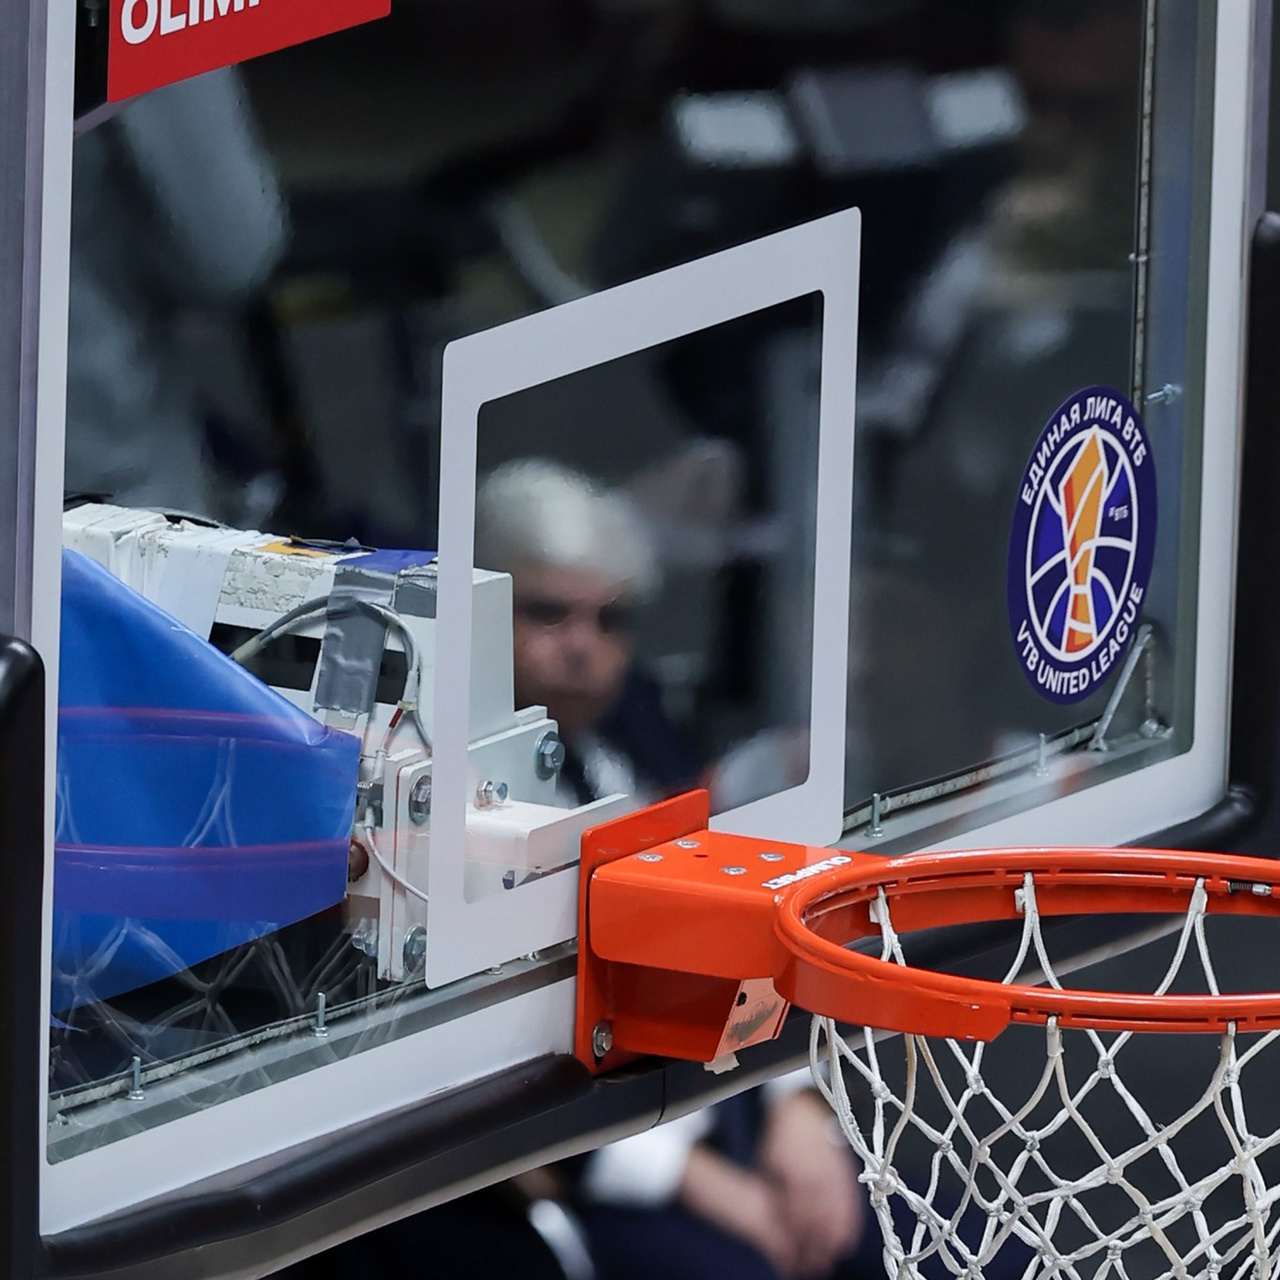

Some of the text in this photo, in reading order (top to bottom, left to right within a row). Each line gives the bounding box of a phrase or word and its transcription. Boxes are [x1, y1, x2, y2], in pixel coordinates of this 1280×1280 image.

[1021, 396, 1147, 506] ЕДИНАЯ ЛИГА ВТБ
[1016, 582, 1144, 695] VTB UNITED LEAGUE
